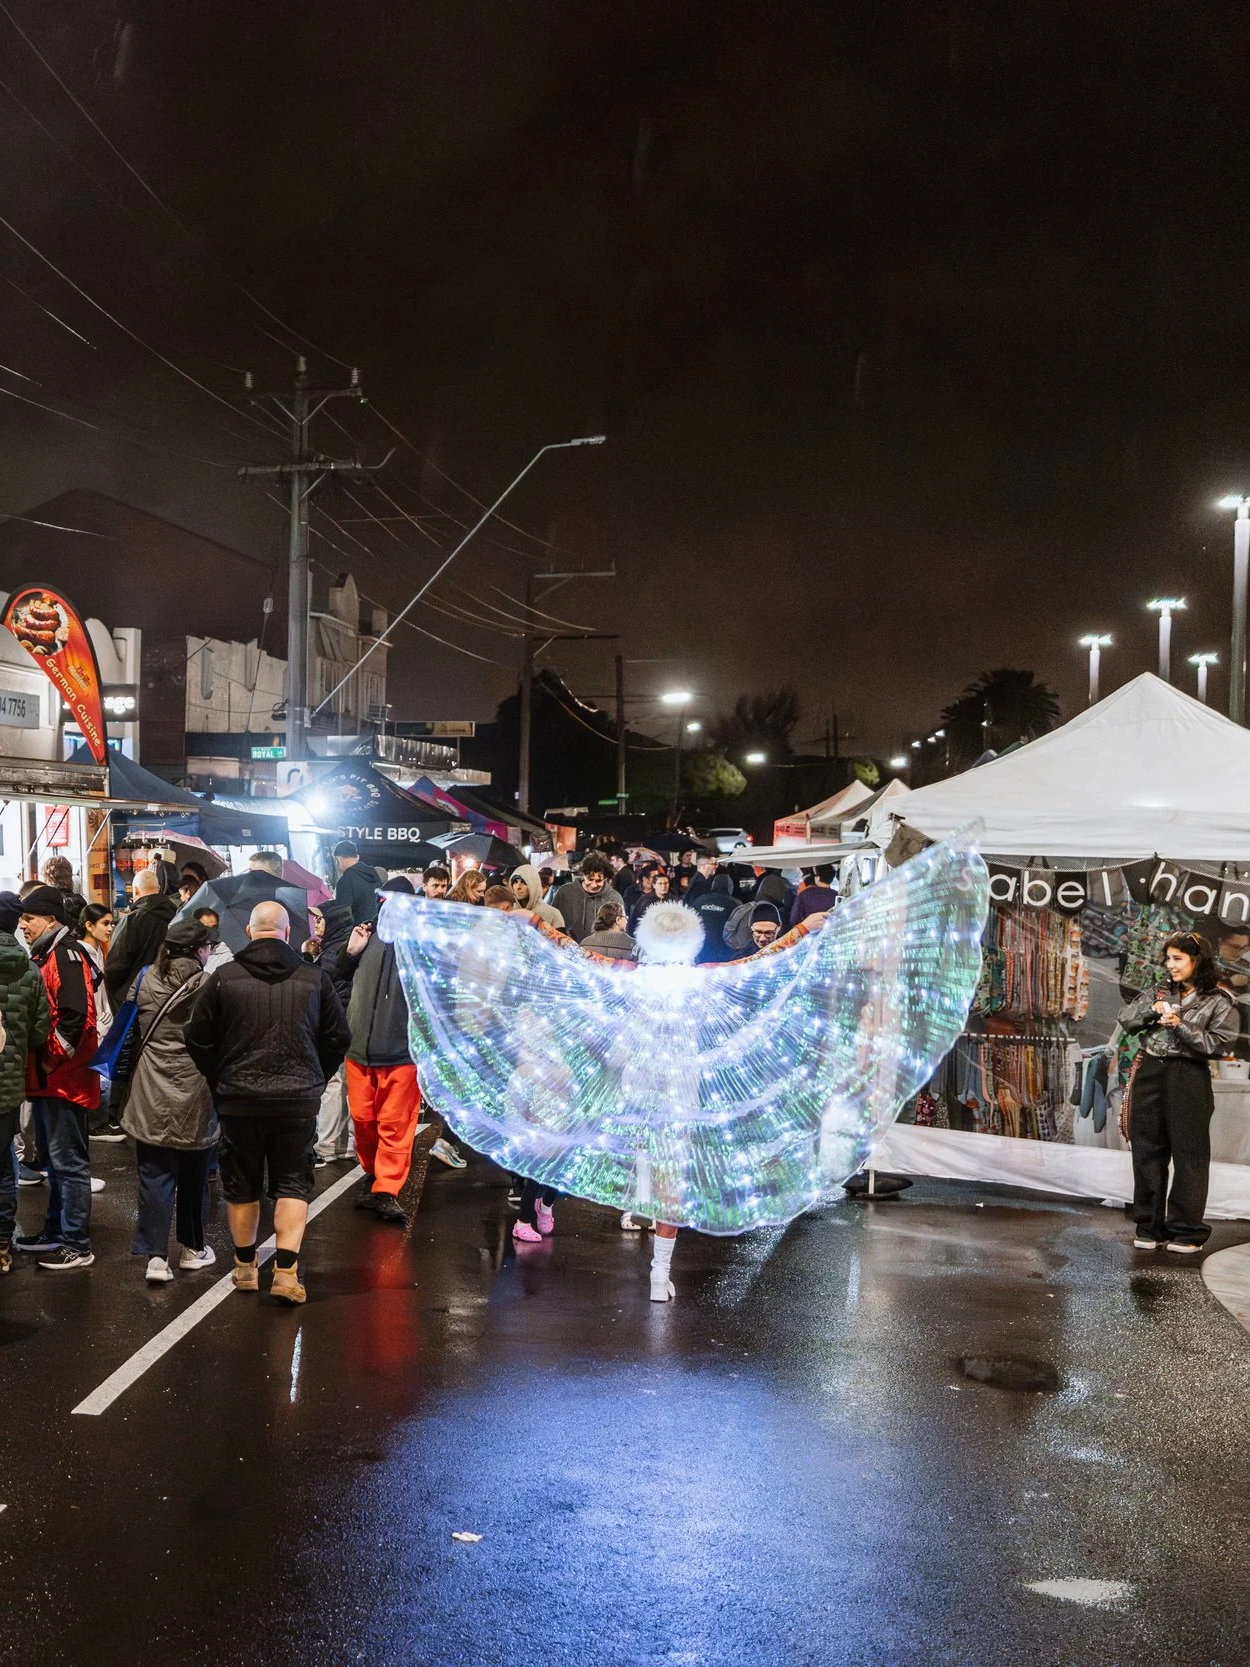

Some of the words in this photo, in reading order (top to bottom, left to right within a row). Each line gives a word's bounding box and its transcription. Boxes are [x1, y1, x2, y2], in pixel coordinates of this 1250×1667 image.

[8, 697, 26, 718] 7756
[46, 658, 78, 702] German
[77, 703, 101, 747] Cuisine
[337, 826, 383, 840] STYLE
[388, 827, 421, 843] BBQ
